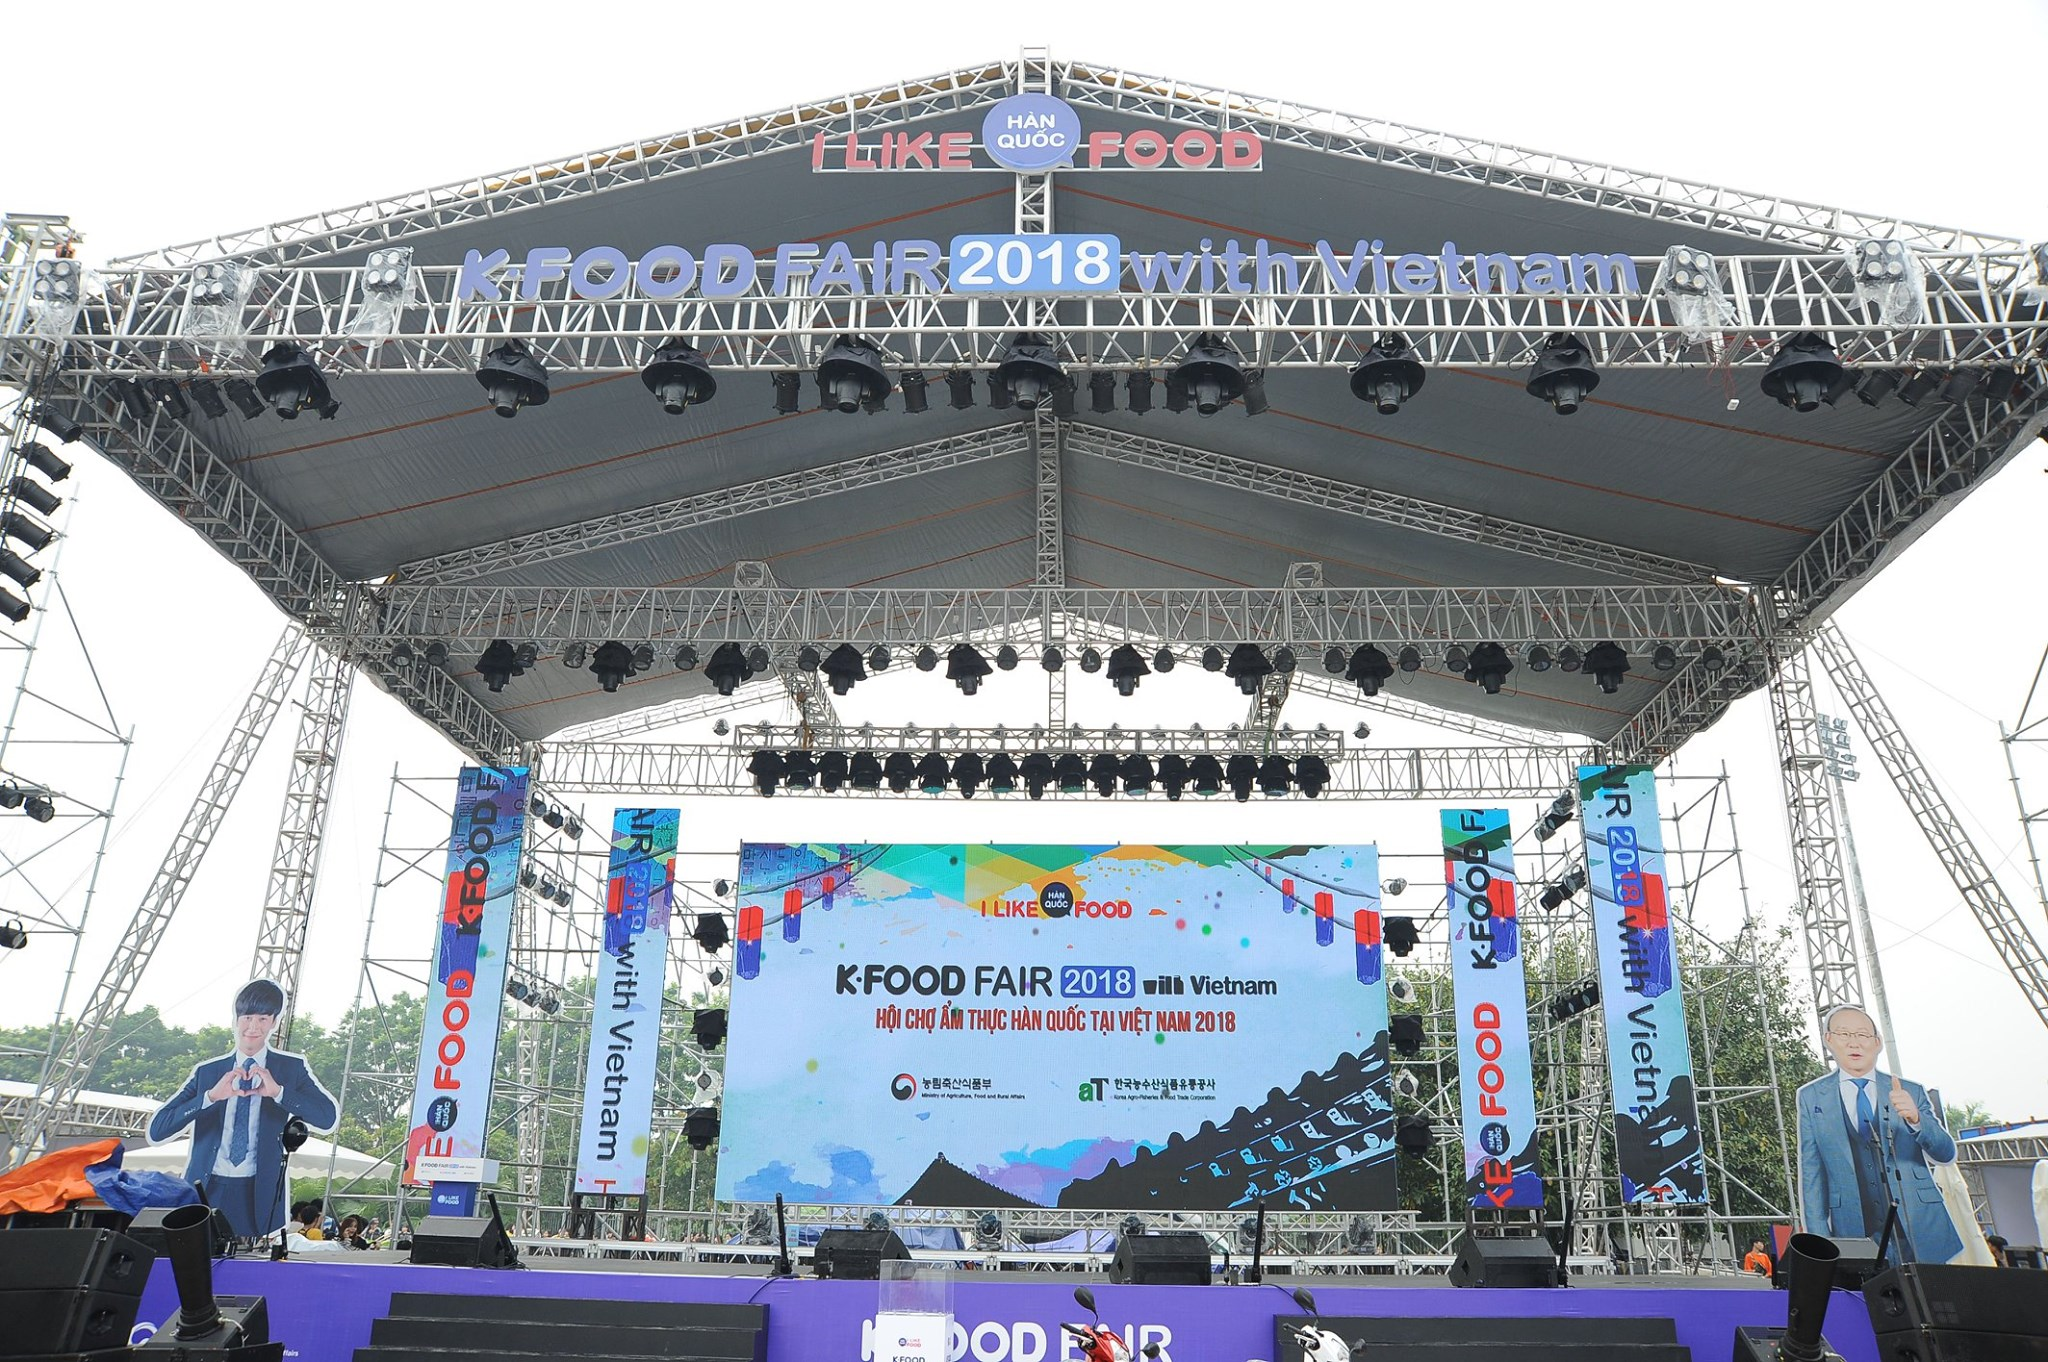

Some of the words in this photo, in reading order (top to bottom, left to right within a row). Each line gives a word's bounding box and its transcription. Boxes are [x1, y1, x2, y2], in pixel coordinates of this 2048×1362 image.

[1007, 111, 1056, 129] HÀN
[812, 132, 826, 169] I
[845, 131, 973, 169] LIKE
[996, 129, 1066, 150] QUỐC
[1088, 130, 1263, 170] FOOD
[774, 240, 943, 297] FAIR
[958, 239, 1111, 287] 2018
[1129, 238, 1300, 295] with
[1314, 238, 1642, 296] Vietnam
[1610, 830, 1640, 902] 2018
[981, 901, 986, 917] I
[993, 901, 1039, 918] LIKE
[1045, 898, 1068, 908] QUỐC
[1048, 891, 1065, 899] HÀN
[1074, 901, 1132, 919] FOOD
[1618, 915, 1651, 993] with
[612, 942, 639, 1010] with
[974, 966, 1053, 997] FAIR
[1063, 968, 1132, 996] 2018
[1190, 975, 1277, 995] Vietnam
[434, 969, 474, 1090] FOOD
[876, 1004, 902, 1033] HỘI
[905, 1007, 937, 1034] CHỢ
[939, 1000, 964, 1030] ẨM
[967, 1008, 1007, 1034] THỰC
[1011, 1006, 1042, 1031] HÀN
[1046, 1004, 1086, 1032] QUỐC
[1089, 1010, 1115, 1036] TẠI
[1118, 1007, 1153, 1037] VIỆT
[1156, 1011, 1191, 1032] NAM
[1195, 1011, 1236, 1032] 2018
[1473, 1001, 1507, 1117] FOOD
[597, 1020, 635, 1162] Vietnam
[922, 1077, 992, 1090] 농림축산식품부
